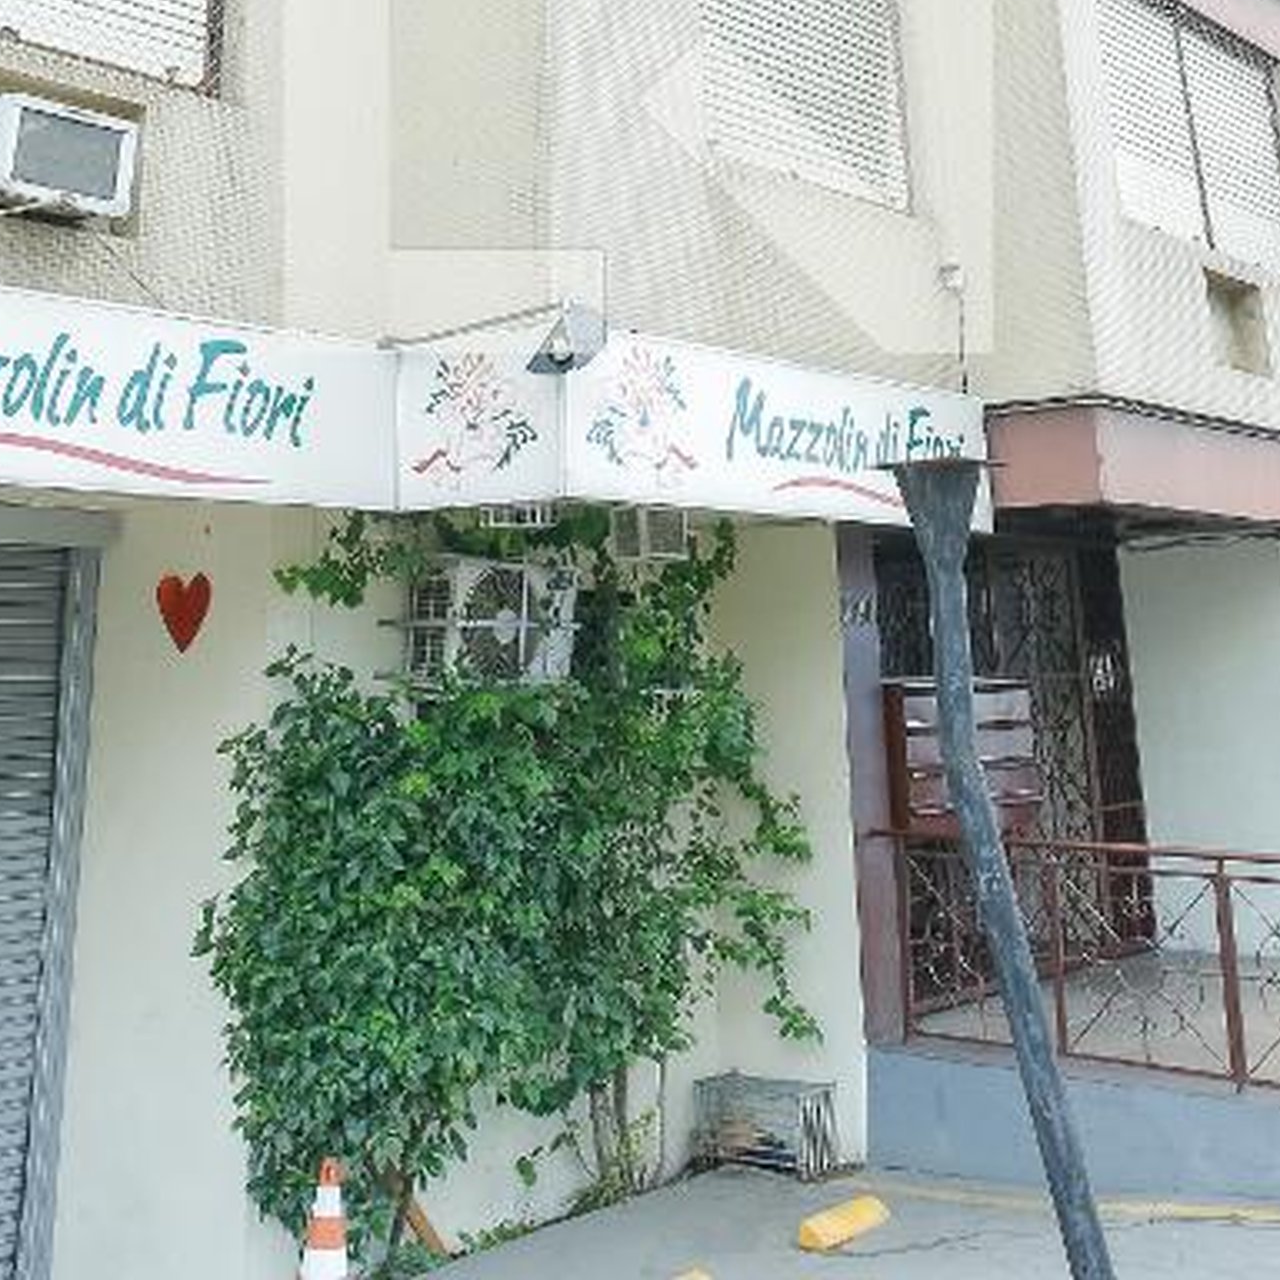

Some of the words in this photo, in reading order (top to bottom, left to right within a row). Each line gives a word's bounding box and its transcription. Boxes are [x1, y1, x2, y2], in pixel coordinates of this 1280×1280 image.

[119, 341, 178, 433] di
[183, 339, 315, 448] Fiori
[725, 375, 870, 473] Mazzolin
[876, 411, 902, 467] di
